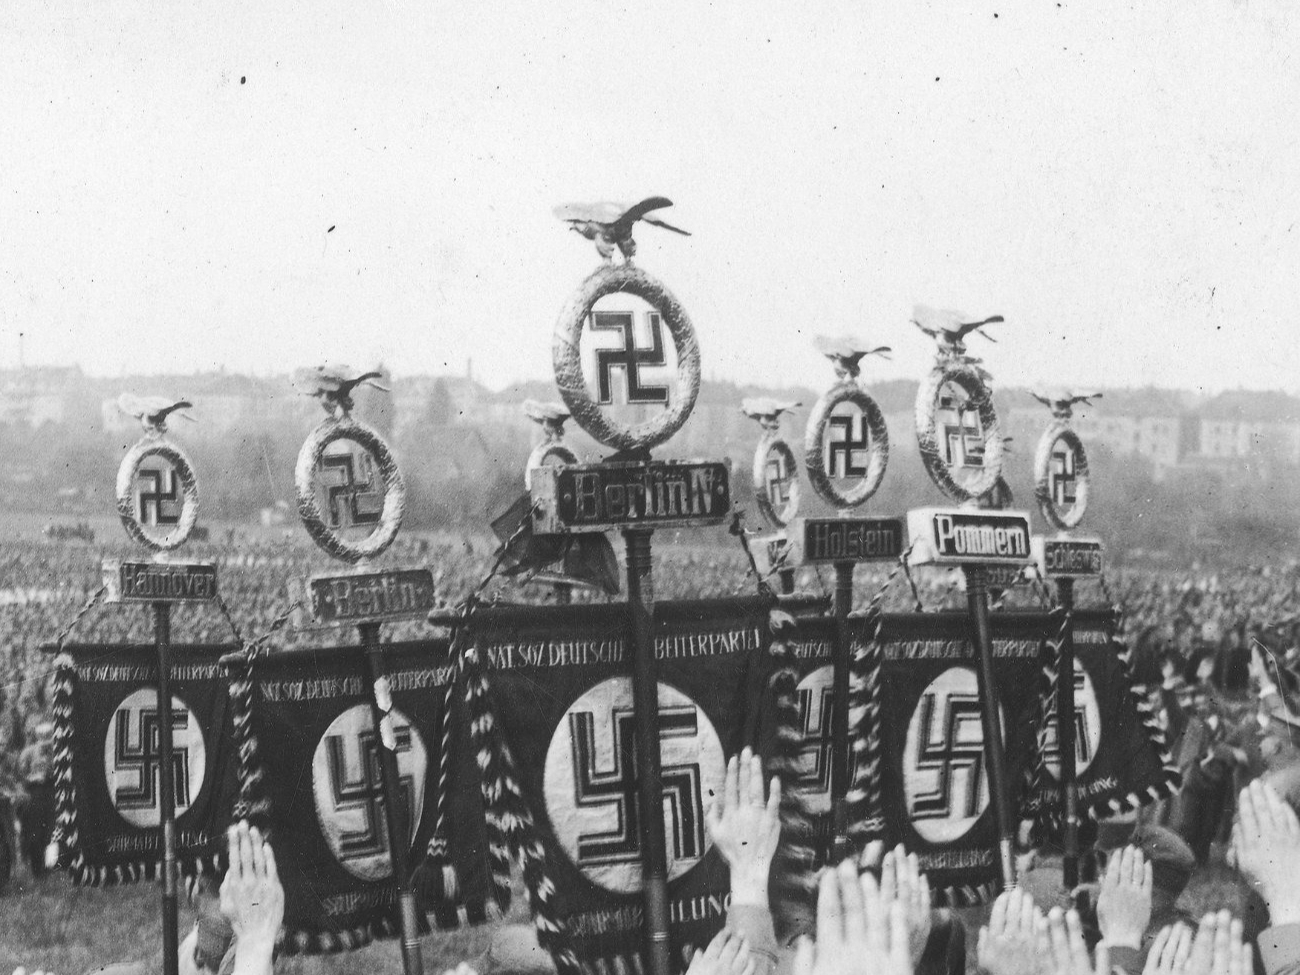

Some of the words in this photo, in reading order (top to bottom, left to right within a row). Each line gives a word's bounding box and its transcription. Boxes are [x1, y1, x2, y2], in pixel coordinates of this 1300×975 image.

[572, 466, 689, 519] Berlin
[815, 523, 894, 558] Holstein
[936, 514, 1028, 556] Pommern
[122, 566, 215, 596] Hannover
[330, 577, 418, 616] Berlin
[654, 626, 761, 660] BEITERPARTEI
